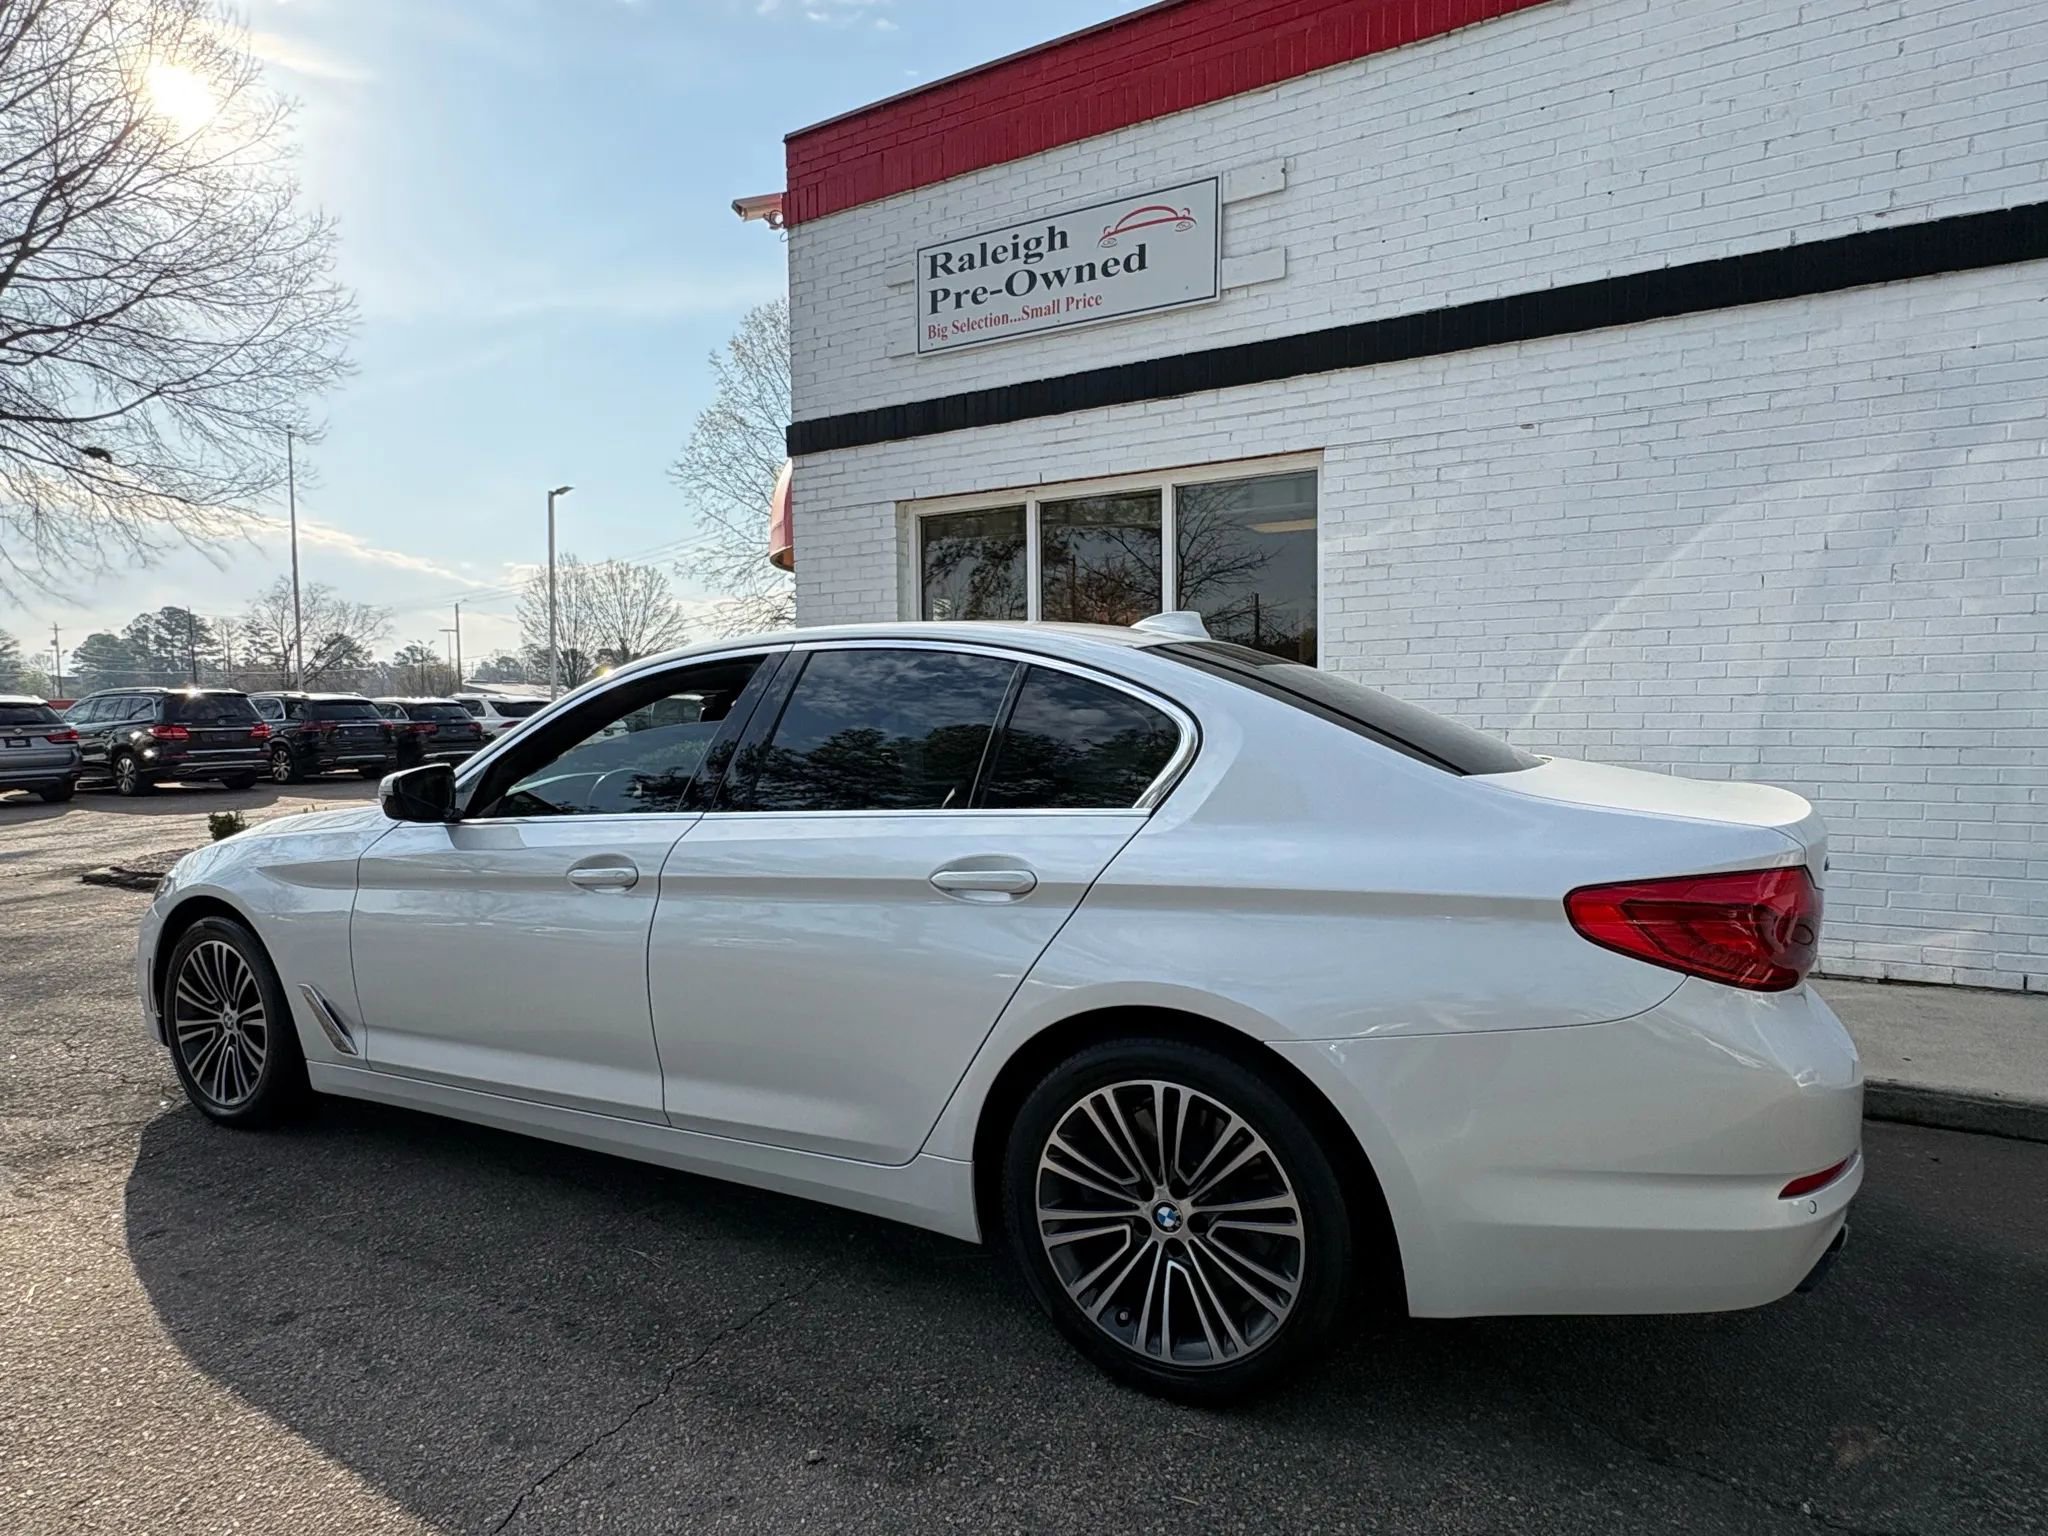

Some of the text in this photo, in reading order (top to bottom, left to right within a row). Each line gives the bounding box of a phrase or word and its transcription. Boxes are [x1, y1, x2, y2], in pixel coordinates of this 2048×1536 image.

[927, 225, 1069, 280] Raleigh
[927, 243, 1148, 315] Pre-Owned
[927, 323, 949, 341] Big
[1065, 292, 1103, 313] Price
